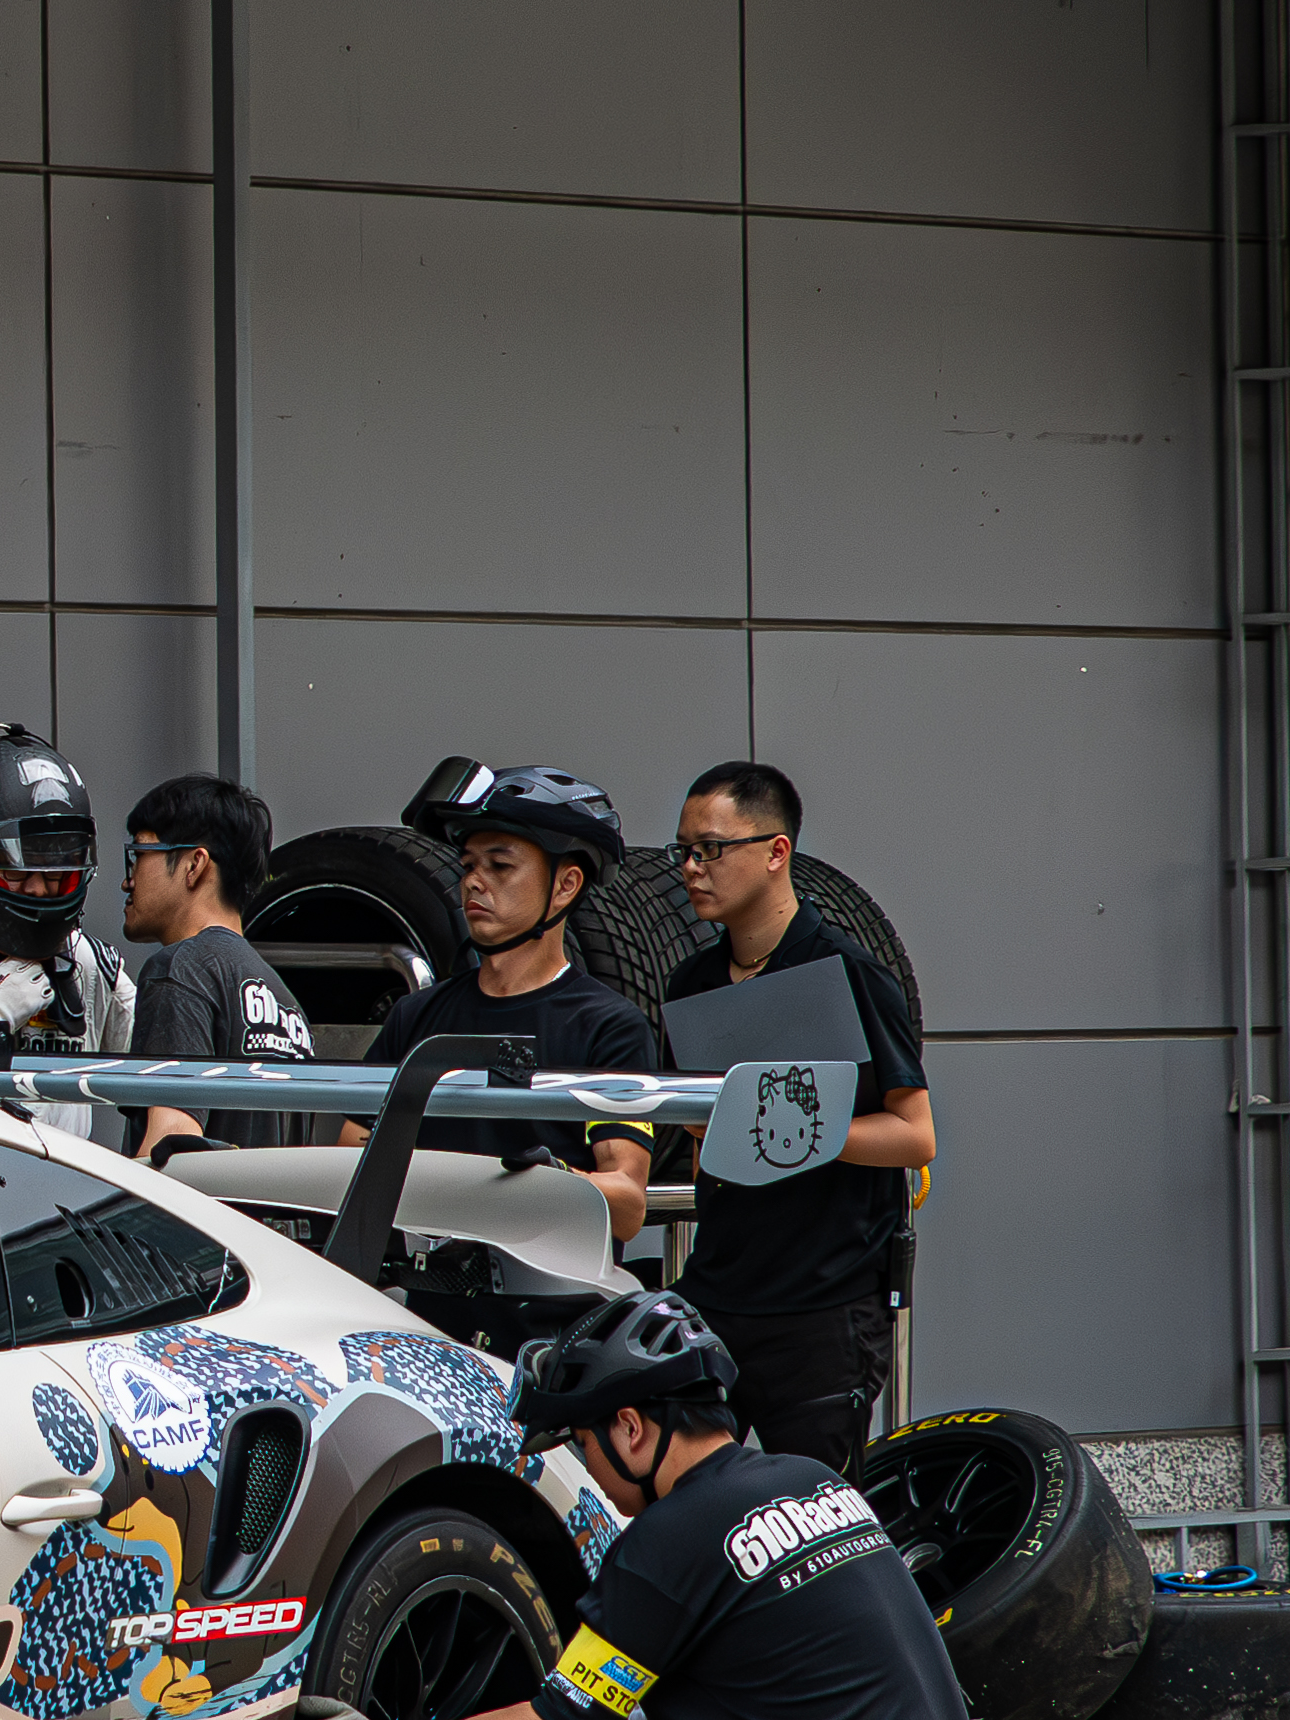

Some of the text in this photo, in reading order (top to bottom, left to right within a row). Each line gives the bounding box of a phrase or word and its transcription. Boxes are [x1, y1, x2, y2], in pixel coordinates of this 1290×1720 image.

[132, 1419, 205, 1449] CAMF
[887, 1412, 1000, 1441] ZERO
[807, 1531, 890, 1573] 610AUTOGRO
[571, 1662, 604, 1689] PIT
[603, 1685, 636, 1713] STO
